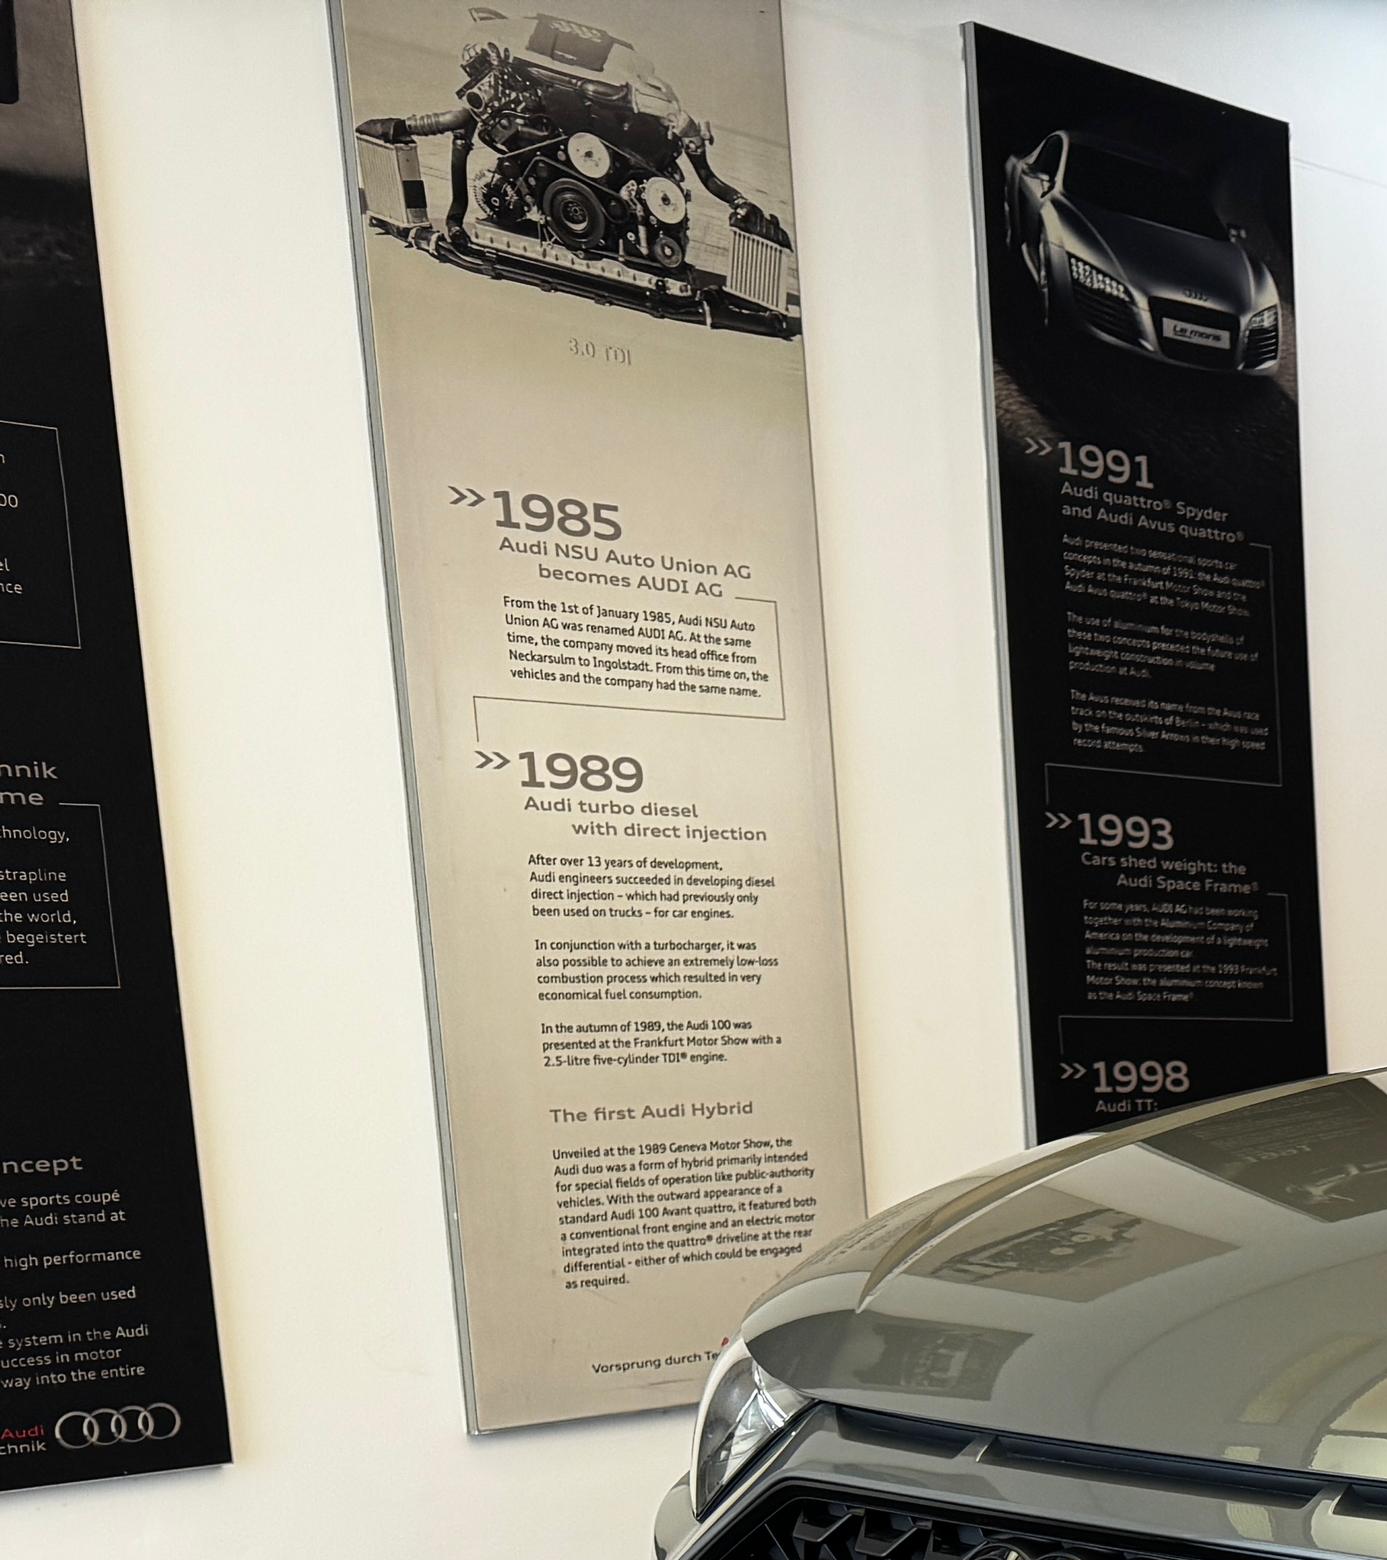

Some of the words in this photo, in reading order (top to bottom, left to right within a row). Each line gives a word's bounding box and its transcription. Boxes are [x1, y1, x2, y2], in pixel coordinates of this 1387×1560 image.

[1057, 440, 1155, 488] 1991
[1060, 480, 1099, 500] Audi
[1175, 500, 1229, 522] Spyder
[492, 490, 623, 541] 1985
[1061, 504, 1093, 519] and
[1096, 506, 1134, 525] Audi
[1136, 514, 1176, 533] Avus
[498, 535, 549, 556] Audi
[554, 541, 599, 562] NSU
[604, 548, 656, 568] Auto
[660, 554, 719, 576] Union
[722, 562, 752, 580] AG
[537, 562, 632, 588] becomes
[636, 574, 690, 594] AUDI
[694, 580, 724, 598] AG
[502, 594, 535, 609] From
[536, 598, 558, 613] the
[560, 600, 580, 615] 1st
[581, 603, 595, 616] of
[595, 604, 640, 623] January
[642, 609, 676, 626] 1985,
[677, 613, 703, 627] Audi
[704, 615, 728, 629] NSU
[729, 618, 756, 632] Auto
[504, 612, 540, 627] Union
[541, 616, 560, 630] AG
[560, 621, 584, 632] was
[585, 623, 636, 637] renamed
[636, 626, 666, 640] AUDI
[688, 630, 703, 644] At
[702, 632, 722, 646] the
[723, 636, 752, 648] same
[539, 633, 561, 648] the
[562, 638, 614, 655] company
[615, 643, 654, 656] moved
[655, 644, 670, 657] its
[670, 645, 698, 660] head
[699, 648, 730, 663] office
[730, 650, 758, 665] from
[508, 648, 577, 665] Neckarsulm
[577, 655, 591, 667] to
[655, 660, 684, 675] From
[684, 663, 707, 677] this
[706, 666, 732, 679] time
[750, 669, 770, 682] the
[509, 666, 558, 682] vehicles
[558, 670, 581, 683] and
[582, 671, 603, 685] the
[603, 676, 654, 692] company
[655, 677, 677, 691] had
[677, 680, 697, 693] the
[698, 683, 728, 695] same
[728, 686, 762, 698] name.
[518, 751, 644, 793] 1989
[523, 795, 573, 812] Audi
[577, 799, 636, 815] turbo
[640, 801, 699, 818] diesel
[570, 820, 618, 836] with
[623, 822, 682, 839] direct
[685, 824, 768, 843] injection
[1077, 812, 1175, 850] 1993
[527, 852, 558, 866] After
[559, 856, 585, 867] over
[587, 854, 602, 868] 13
[603, 858, 635, 871] years
[635, 855, 648, 869] of
[1080, 850, 1117, 867] Cars
[1119, 854, 1158, 869] shed
[1159, 858, 1219, 875] weight:
[1220, 861, 1248, 875] the
[1115, 872, 1153, 888] Audi
[1155, 874, 1202, 892] Space
[33, 889, 69, 902] used
[27, 910, 77, 926] world,
[6, 930, 88, 947] begeistert
[537, 988, 603, 1001] economical
[604, 987, 628, 1000] fuel
[628, 988, 703, 1001] consumption.
[543, 1054, 592, 1067] 2.5-litre
[592, 1052, 660, 1067] five-cylinder
[689, 1051, 728, 1065] engine.
[1092, 1059, 1190, 1093] 1998
[548, 1107, 588, 1123] The
[593, 1106, 637, 1121] first
[640, 1102, 686, 1119] Audi
[690, 1100, 754, 1120] Hybrid
[1094, 1098, 1132, 1113] Audi
[1135, 1097, 1159, 1112] TT:
[21, 1193, 71, 1210] sports
[74, 1189, 121, 1206] coupé
[23, 1212, 59, 1227] Audi
[63, 1209, 106, 1225] stand
[110, 1209, 127, 1222] at
[4, 1254, 39, 1271] high
[43, 1248, 142, 1269] performance
[22, 1292, 55, 1309] only
[59, 1291, 97, 1305] been
[101, 1285, 137, 1301] used
[7, 1333, 64, 1351] system
[67, 1330, 82, 1343] in
[86, 1328, 112, 1342] the
[115, 1323, 150, 1339] Audi
[56, 1351, 70, 1364] in
[74, 1348, 123, 1363] motor
[591, 1357, 662, 1374] Vorsprung
[664, 1352, 703, 1366] durch
[0, 1376, 32, 1390] way
[36, 1372, 67, 1385] into
[70, 1369, 97, 1382] the
[101, 1364, 146, 1379] entire
[0, 1424, 46, 1440] Audi
